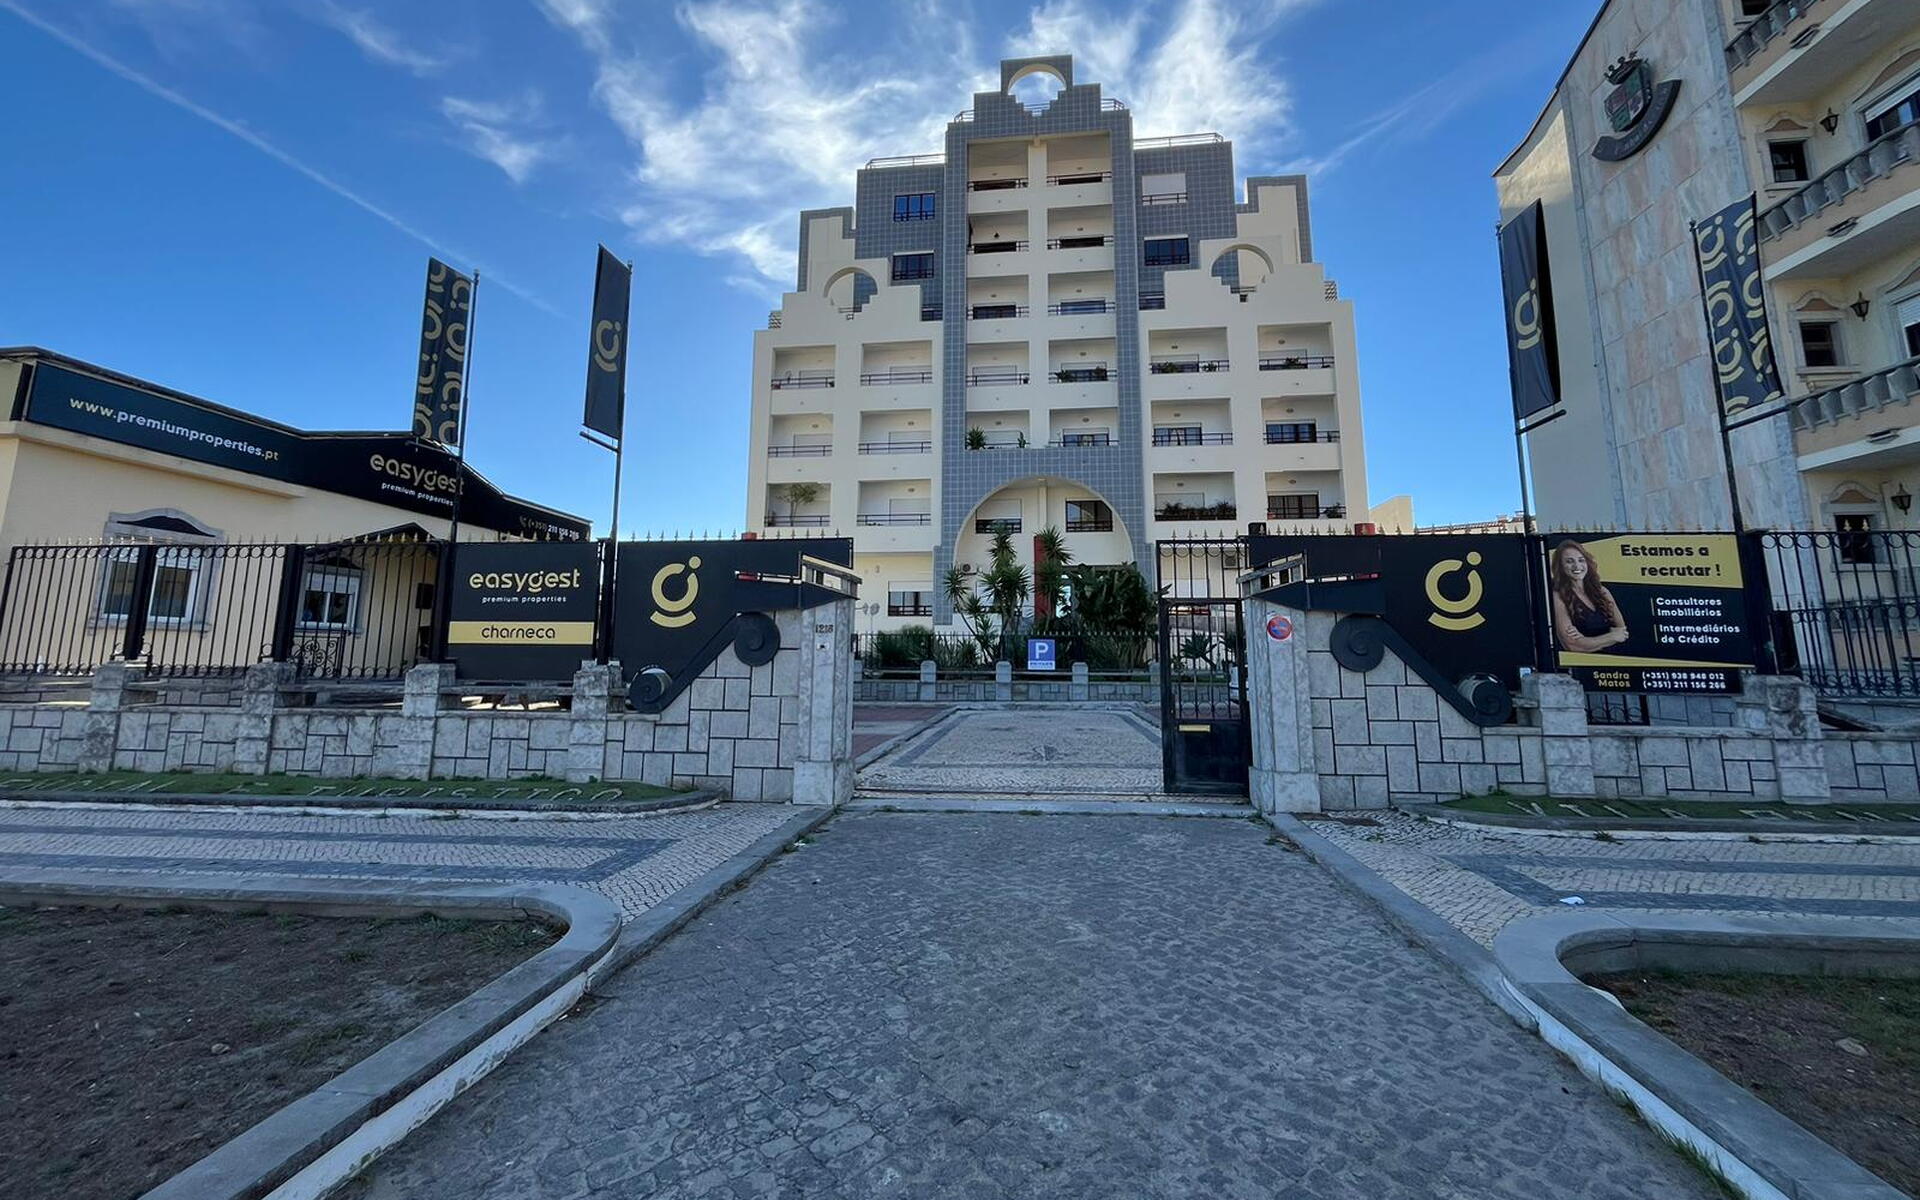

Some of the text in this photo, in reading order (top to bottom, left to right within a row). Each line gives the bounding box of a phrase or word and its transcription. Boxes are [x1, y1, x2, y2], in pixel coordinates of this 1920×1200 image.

[70, 398, 279, 461] www.premiumproperties.pt
[370, 454, 465, 495] easygest
[381, 482, 454, 506] premium properties
[1620, 544, 1710, 557] Estamos a
[1641, 565, 1711, 577] recrutar
[469, 568, 580, 593] easygest
[481, 595, 567, 604] premium properties
[1656, 596, 1722, 606] Consultores
[1657, 607, 1722, 617] Imobiliários
[481, 624, 556, 639] charneca
[1659, 623, 1740, 633] Intermediários
[1661, 633, 1720, 644] de Crédito
[1035, 642, 1049, 660] P
[1593, 671, 1630, 680] Sandra
[1642, 671, 1669, 680] (+351)
[1598, 679, 1631, 688] Matos
[1643, 680, 1671, 689] (+351)
